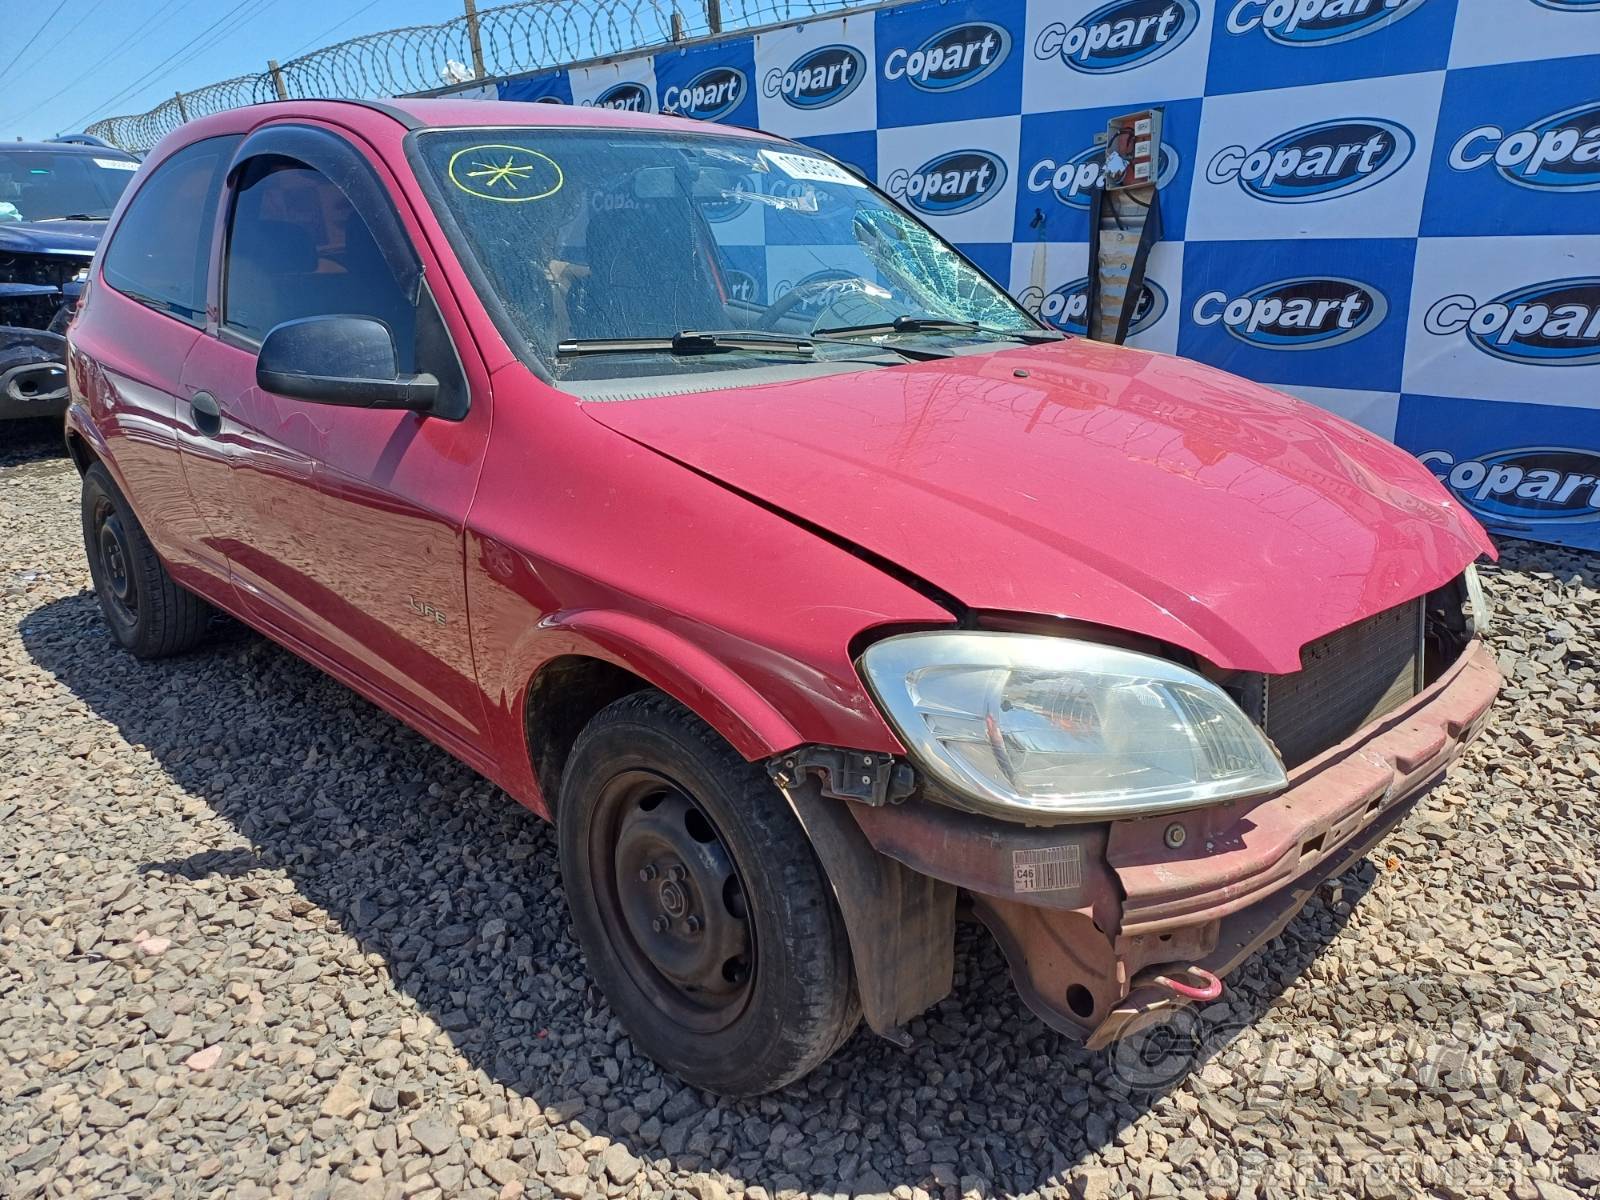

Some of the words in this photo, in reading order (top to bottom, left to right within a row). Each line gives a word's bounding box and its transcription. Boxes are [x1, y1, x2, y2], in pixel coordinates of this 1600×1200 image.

[1034, 2, 1181, 61] Copart
[763, 53, 853, 99] Copart
[884, 33, 995, 82] Copart
[663, 75, 738, 112] Copart
[1206, 129, 1388, 190] Copart
[1447, 125, 1600, 176] Copa
[886, 158, 992, 207] Copart
[1192, 291, 1363, 335] Copart
[408, 593, 447, 627] LIFE
[1016, 869, 1034, 879] C46
